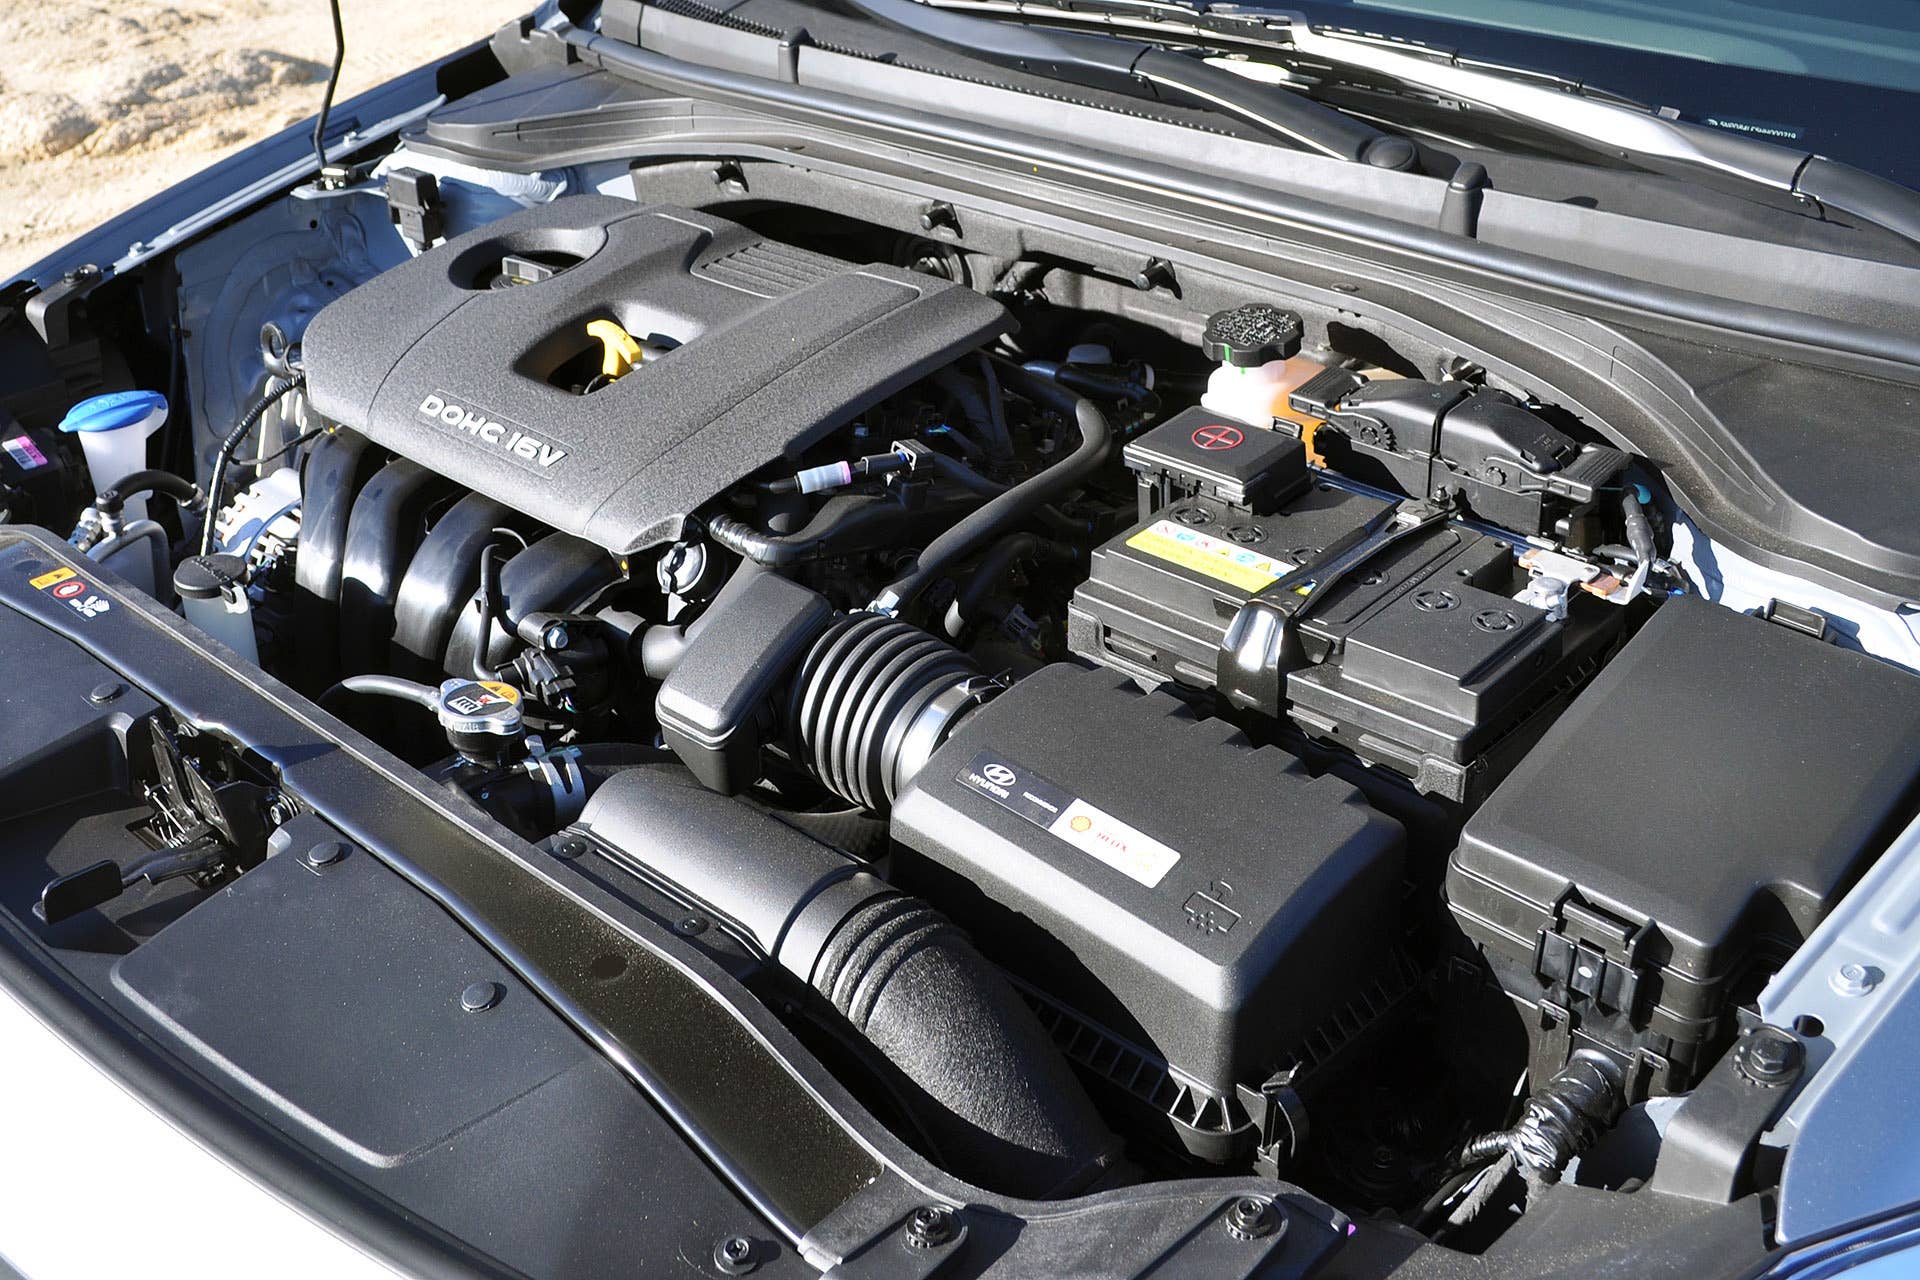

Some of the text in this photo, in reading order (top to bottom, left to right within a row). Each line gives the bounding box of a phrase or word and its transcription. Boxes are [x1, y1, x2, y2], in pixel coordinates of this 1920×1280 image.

[419, 394, 568, 468] DOHC 16V
[968, 772, 1010, 800] HYUNDAI
